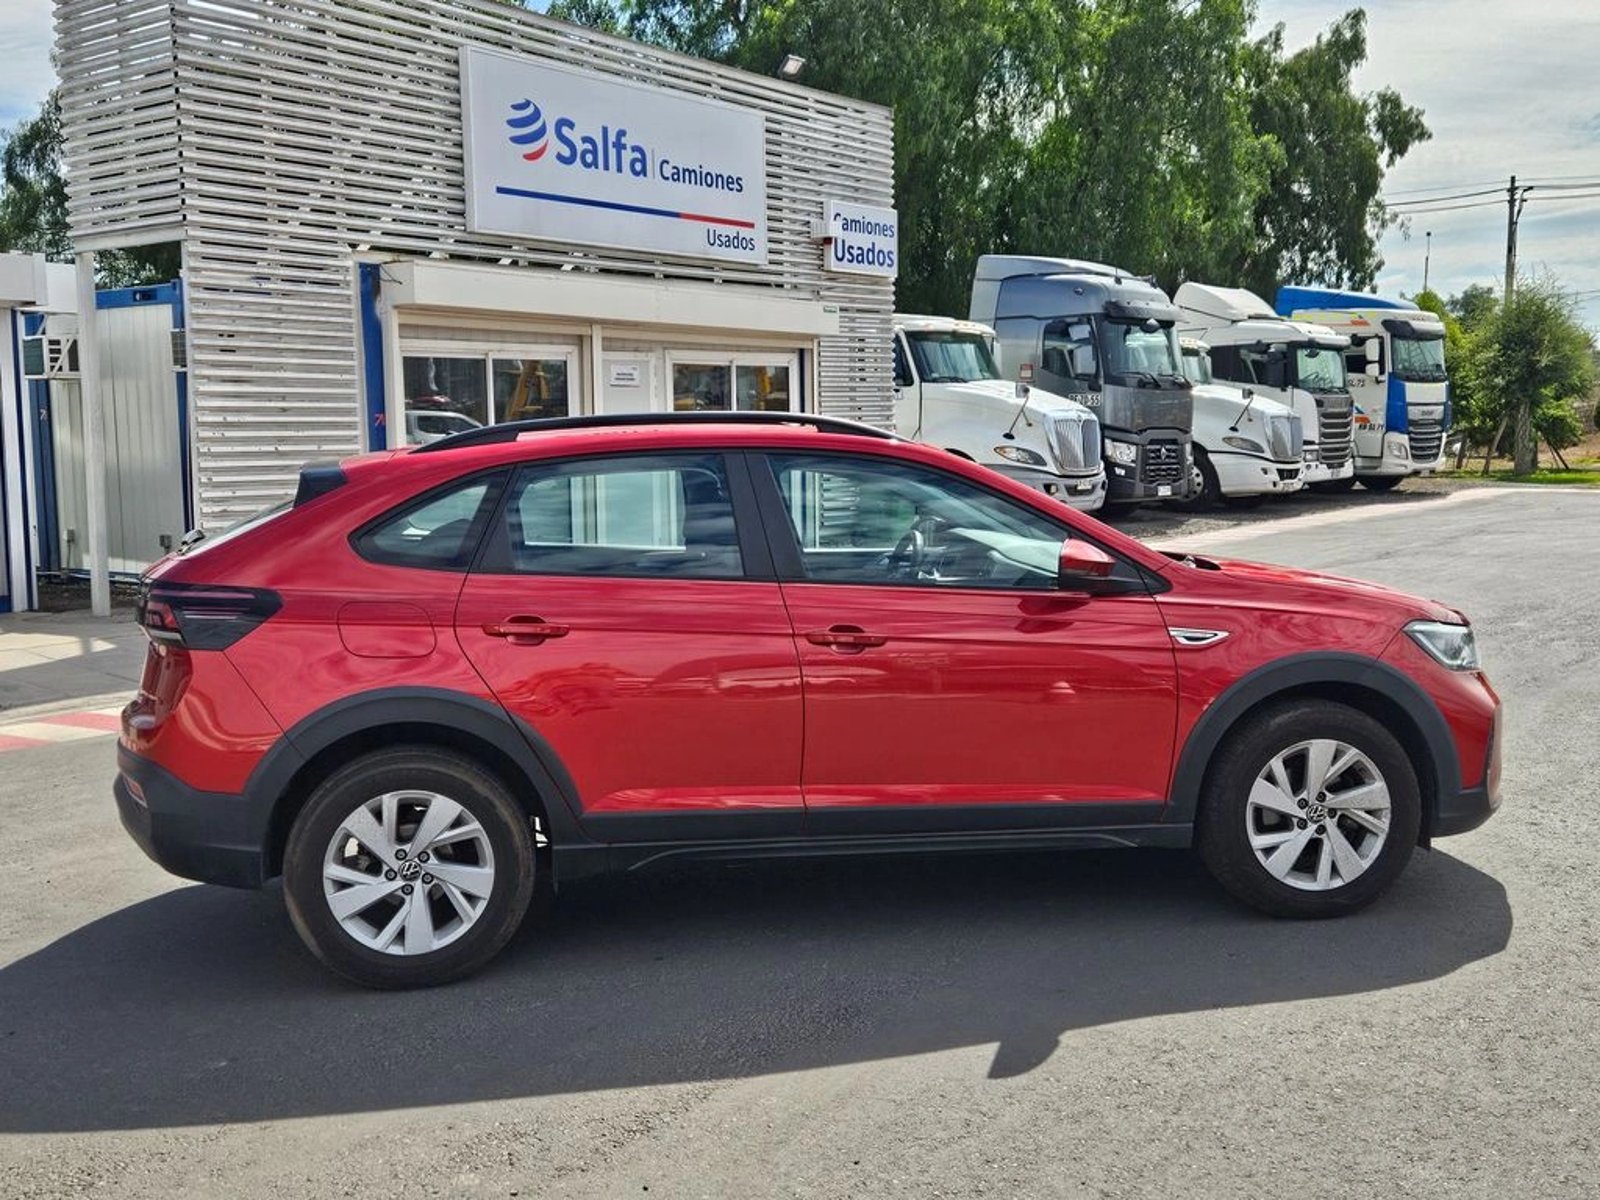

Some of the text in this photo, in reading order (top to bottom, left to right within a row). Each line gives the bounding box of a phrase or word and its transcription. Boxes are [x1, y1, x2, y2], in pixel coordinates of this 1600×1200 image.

[554, 117, 744, 193] Salfa Camiones
[706, 227, 756, 251] Usados
[834, 236, 895, 268] Usados
